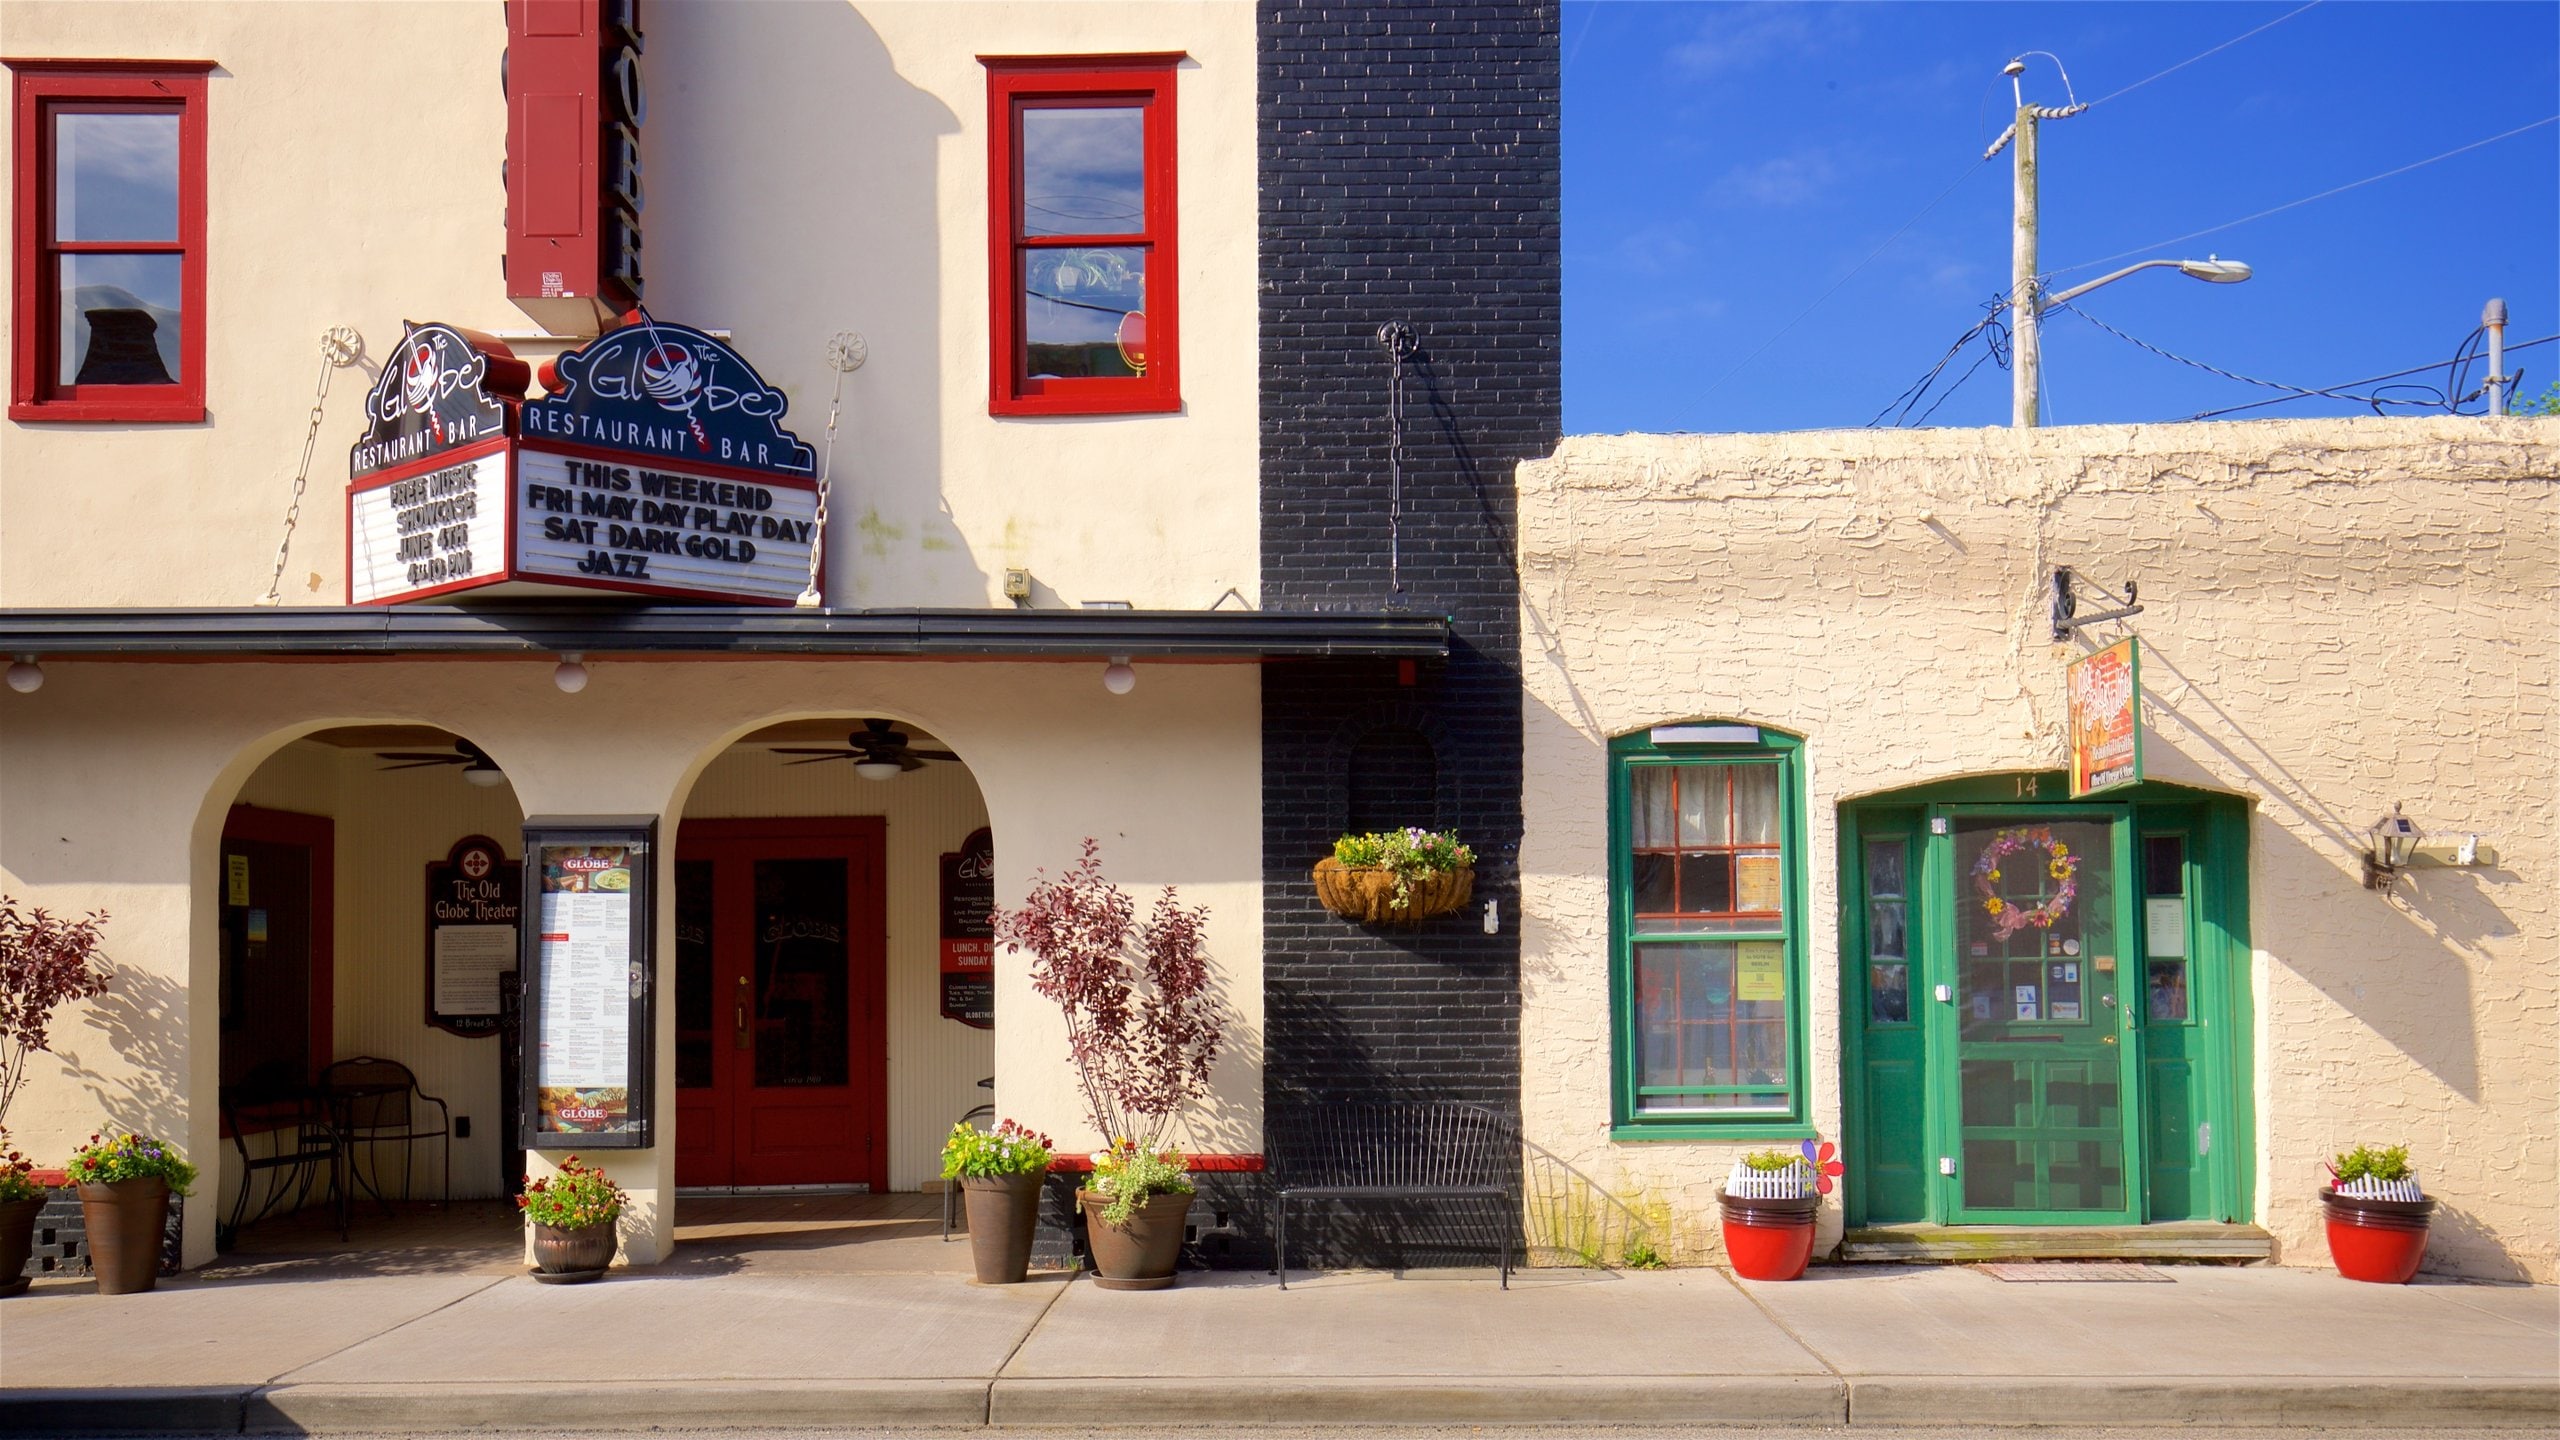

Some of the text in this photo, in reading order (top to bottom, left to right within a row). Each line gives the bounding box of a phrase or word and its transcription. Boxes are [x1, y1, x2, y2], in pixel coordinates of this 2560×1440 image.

[432, 333, 448, 351] The
[692, 343, 720, 362] The
[354, 415, 477, 472] RESTAURANT BAR
[530, 407, 769, 465] RESTAURANT BAR
[390, 463, 478, 508] FREE MUSIC
[565, 460, 773, 511] THIS WEEKEND
[396, 491, 478, 535] SHOWCASE
[528, 484, 813, 544] FRI MAY DAY PLAY DAY
[396, 523, 468, 562] JUNE 4TH
[544, 516, 756, 563] SAT DARK GOLD
[448, 550, 472, 578] PM
[577, 550, 650, 579] JAZZ
[2016, 776, 2038, 798] 14
[567, 859, 609, 869] GLOBE
[452, 879, 501, 901] The Old
[435, 899, 518, 920] Globe Theater
[958, 955, 988, 966] SUNDAY
[561, 1108, 604, 1119] GLOBE
